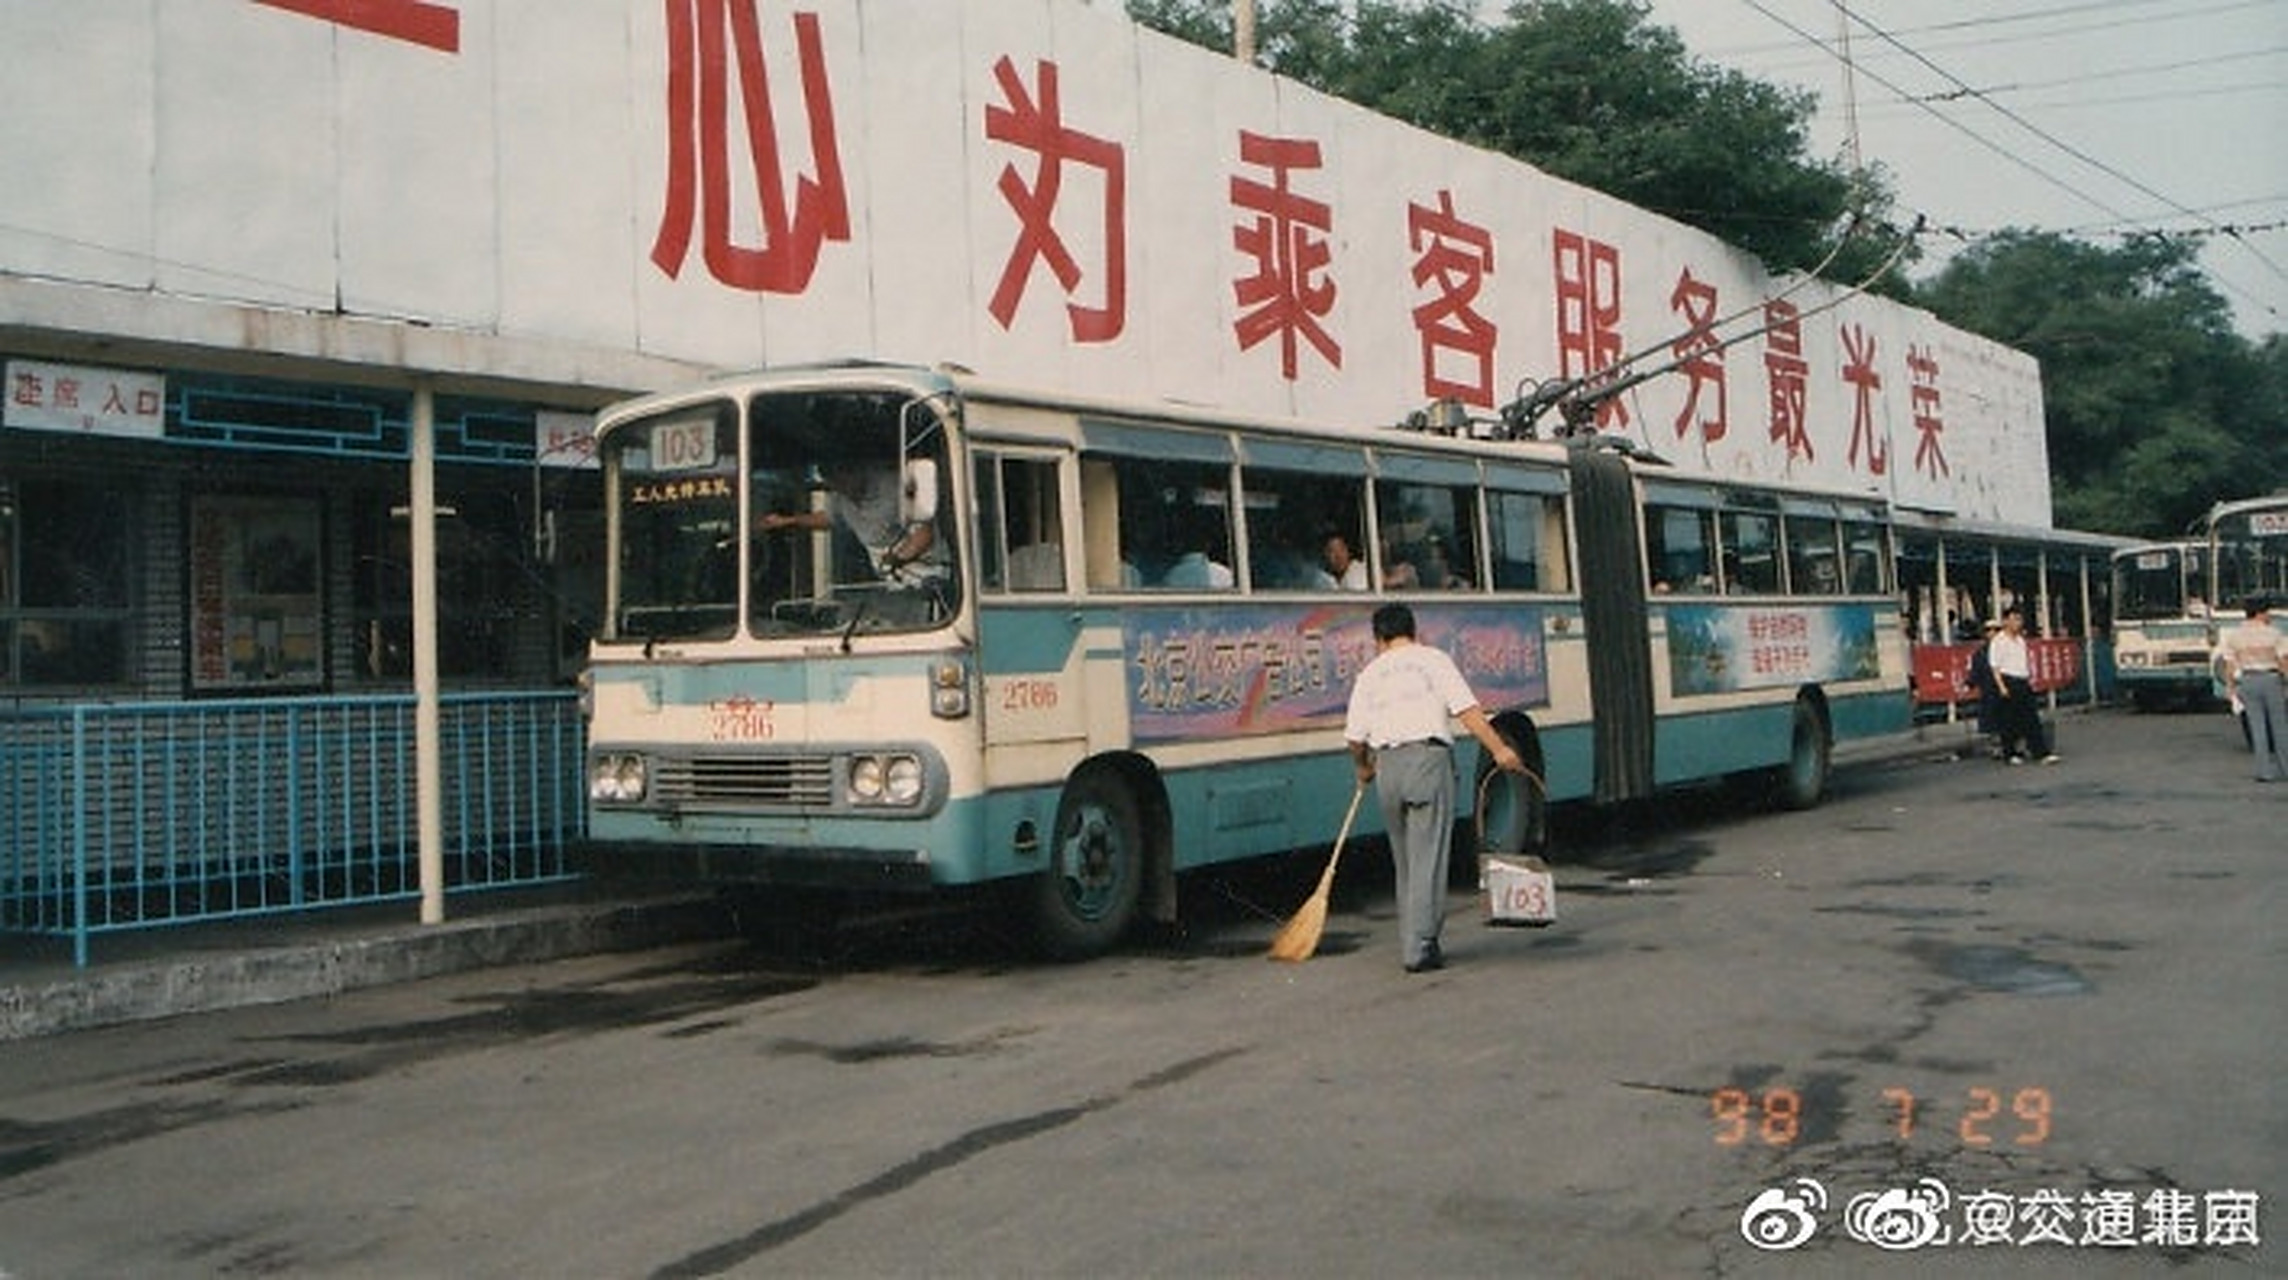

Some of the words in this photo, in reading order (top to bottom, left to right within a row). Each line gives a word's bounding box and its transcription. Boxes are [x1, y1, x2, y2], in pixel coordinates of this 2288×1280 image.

[103, 383, 159, 415] 入口
[661, 425, 705, 465] 103
[1003, 681, 1059, 710] 2786
[712, 714, 774, 740] 2786
[1504, 882, 1547, 917] 103
